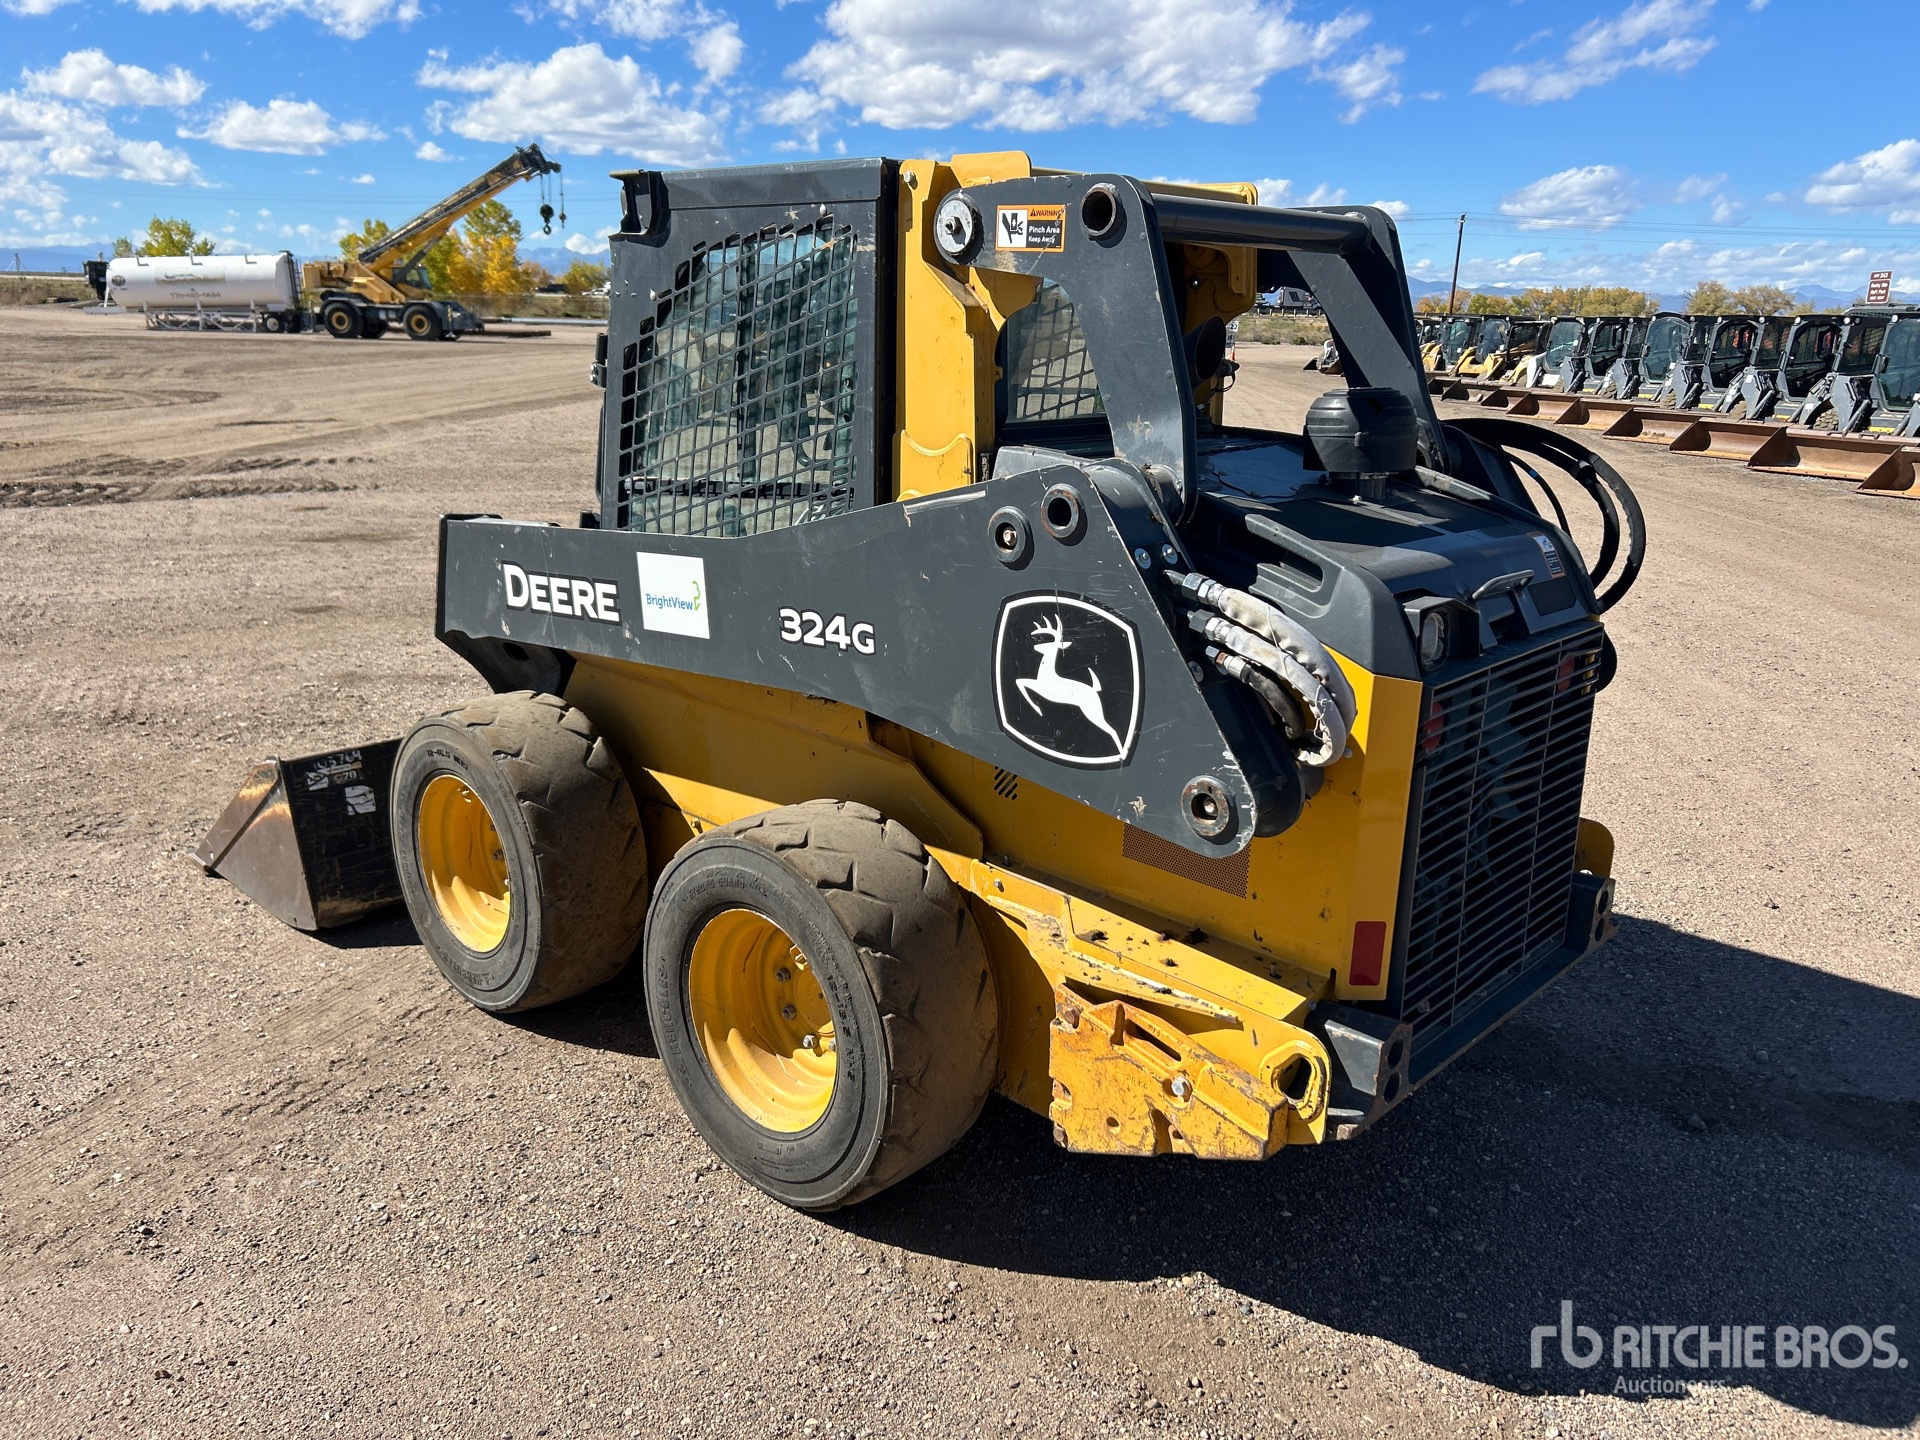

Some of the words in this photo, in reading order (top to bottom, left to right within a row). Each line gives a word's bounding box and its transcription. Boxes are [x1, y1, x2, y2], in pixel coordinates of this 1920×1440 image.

[1028, 225, 1045, 234] Pinch
[1046, 225, 1060, 234] Area
[1028, 235, 1041, 243] Keep
[503, 562, 621, 623] DEERE
[645, 593, 694, 611] BrightView
[780, 607, 875, 654] 324G
